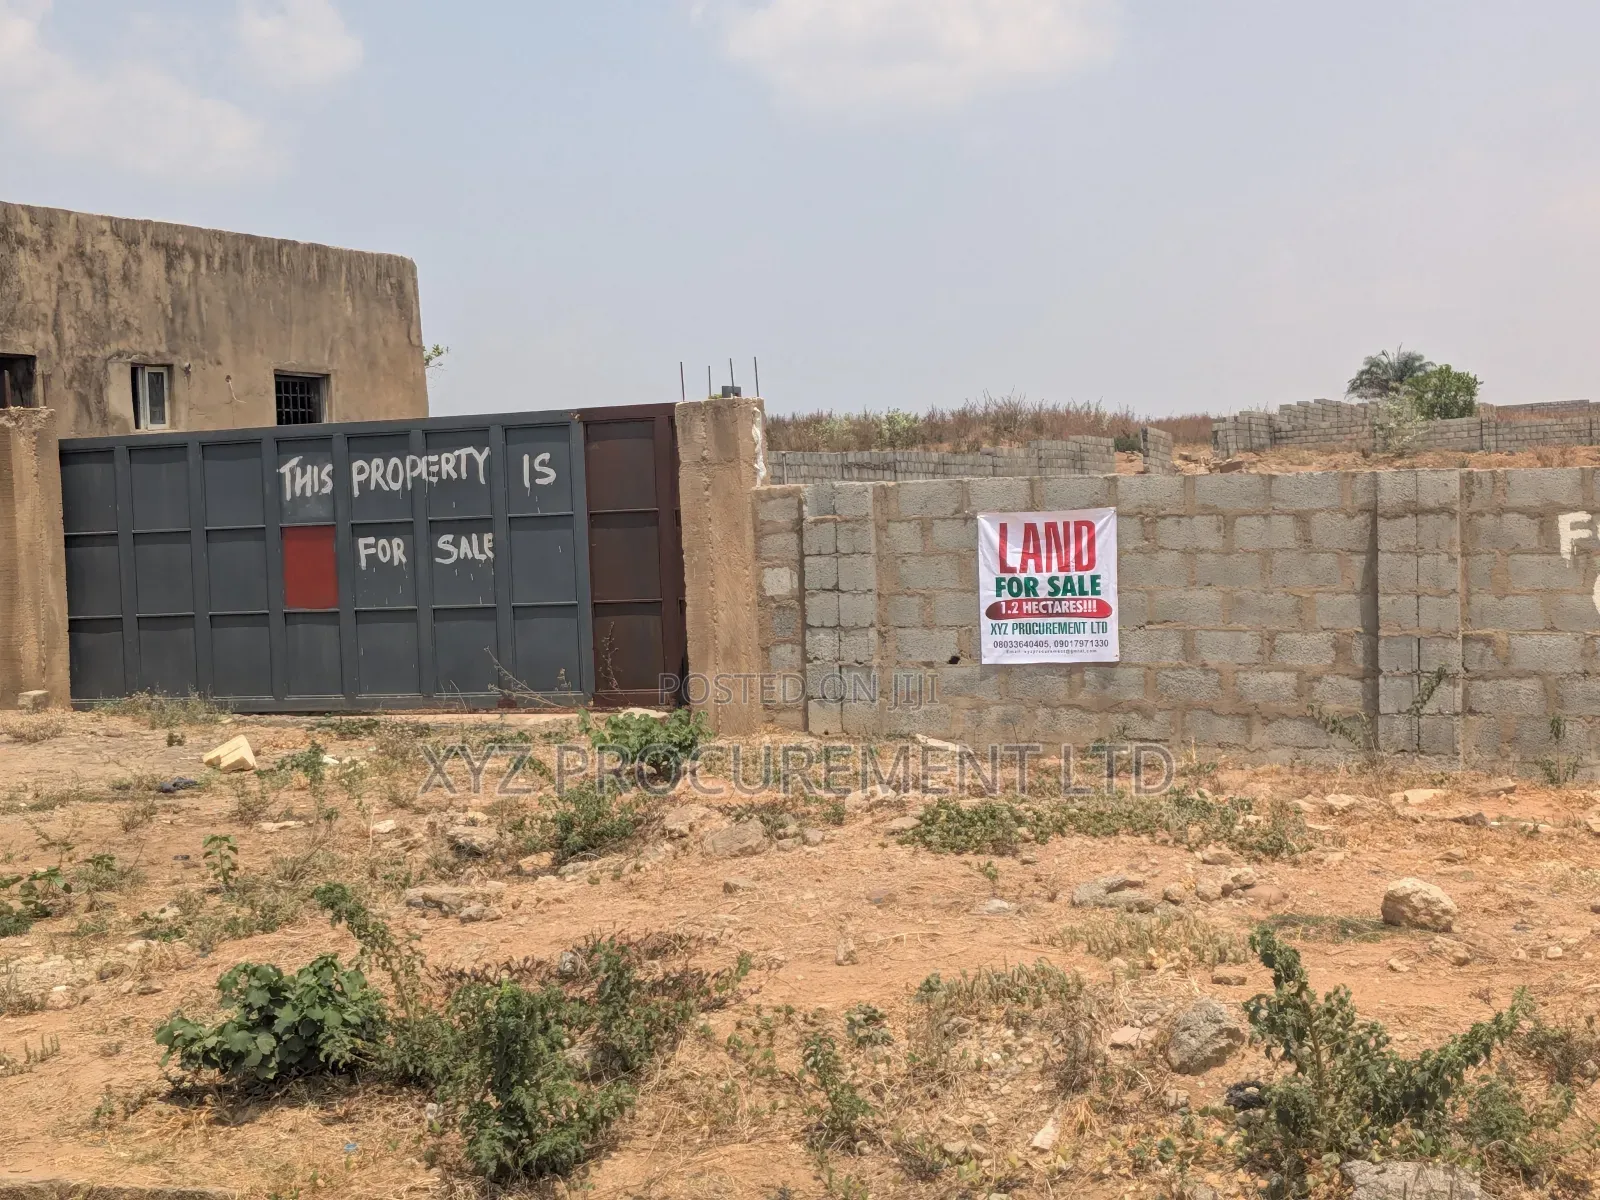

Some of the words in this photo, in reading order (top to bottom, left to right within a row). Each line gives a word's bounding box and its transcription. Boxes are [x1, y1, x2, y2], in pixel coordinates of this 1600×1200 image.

[277, 455, 333, 501] THIS
[352, 446, 491, 498] PROPERTY
[523, 452, 557, 488] IS
[358, 535, 407, 570] FOR
[435, 532, 494, 564] SALE
[999, 520, 1097, 574] LAND
[995, 577, 1039, 597] FOR
[1047, 574, 1101, 597] SALE
[1000, 601, 1019, 615] 1.2
[1023, 600, 1097, 614] HECTARES!!!
[990, 622, 1009, 635] XYZ
[1012, 621, 1086, 635] PROCUREMENT
[1090, 621, 1108, 634] LTD
[993, 640, 1052, 649] 08033640405,
[1054, 639, 1109, 648] 09017971330
